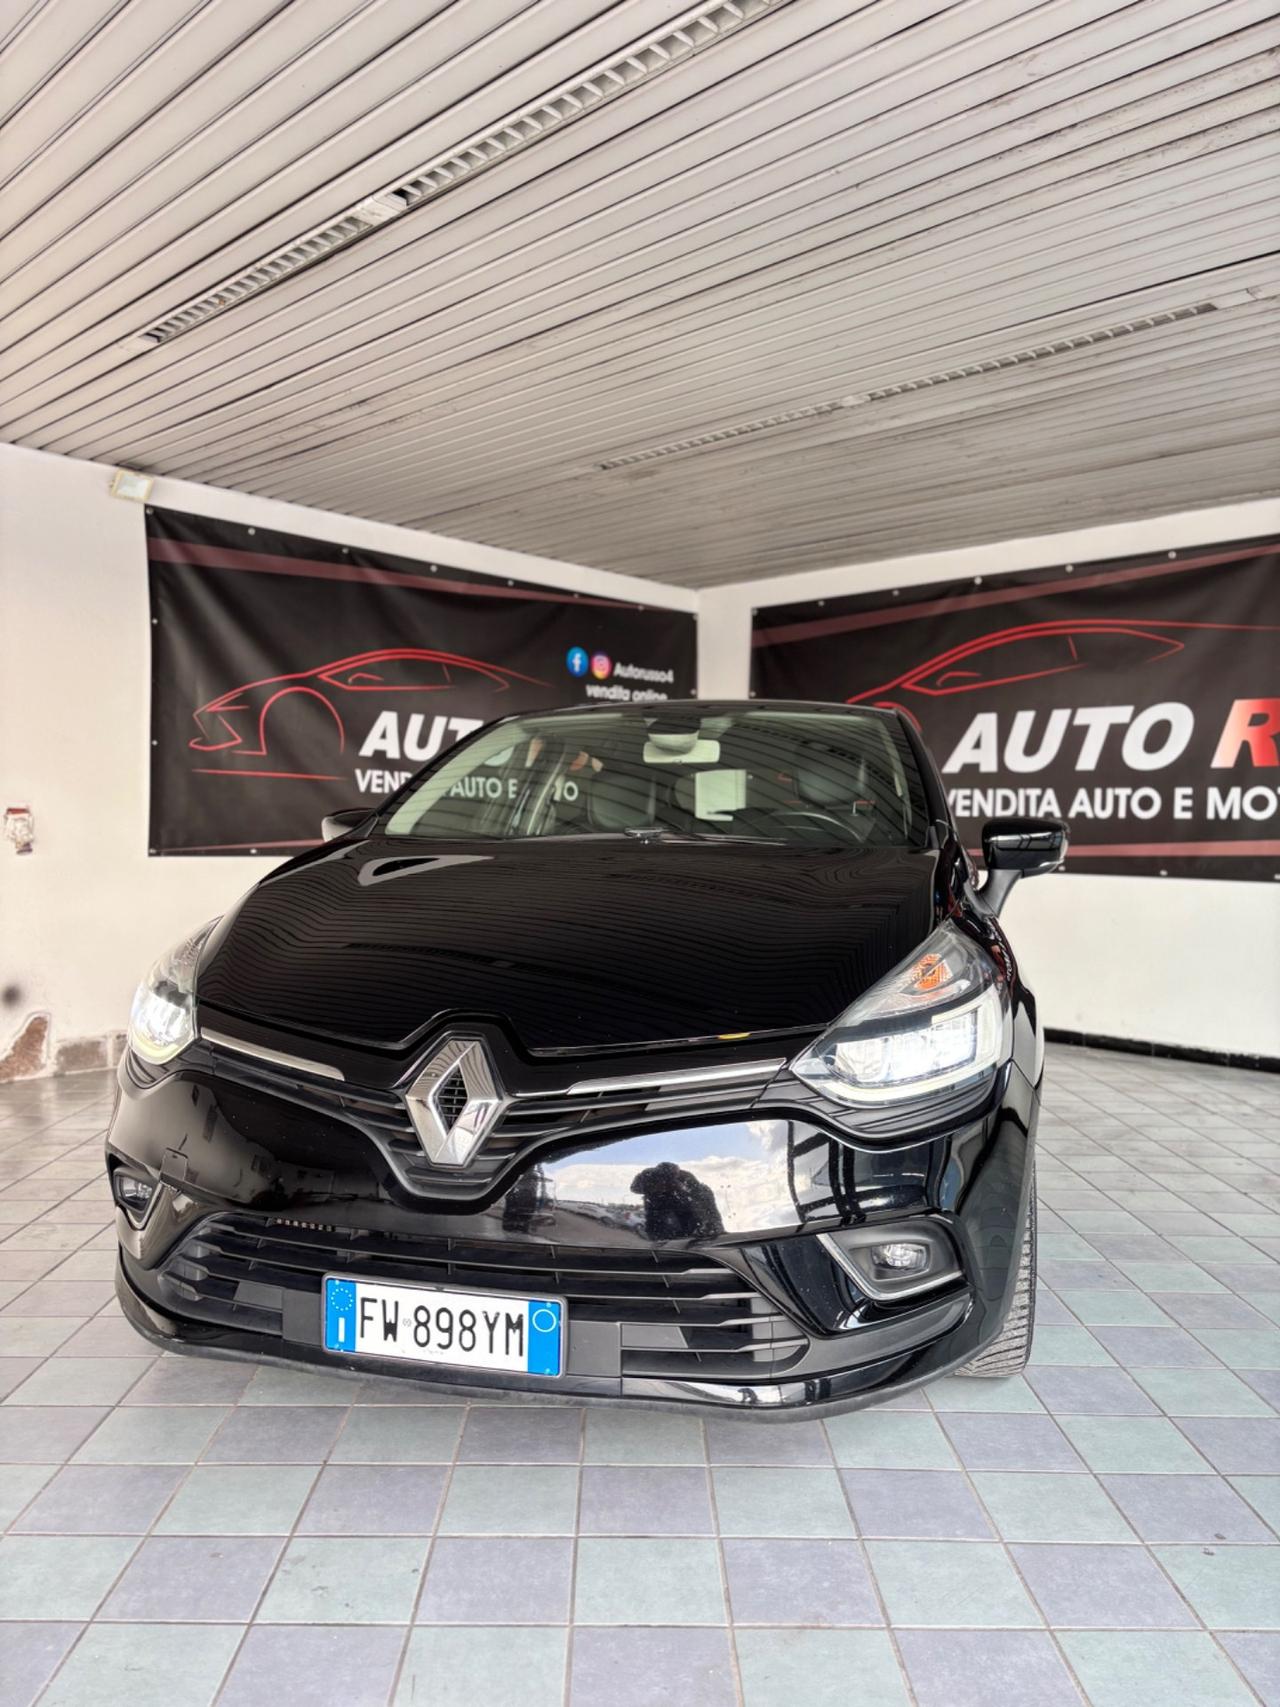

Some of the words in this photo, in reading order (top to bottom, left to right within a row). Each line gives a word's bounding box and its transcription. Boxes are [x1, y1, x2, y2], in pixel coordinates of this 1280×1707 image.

[585, 684, 631, 702] vendita
[632, 689, 668, 703] online
[358, 710, 515, 767] AUT
[941, 702, 1195, 774] AUTO
[1068, 787, 1162, 820] AUTO
[1173, 787, 1193, 820] E
[1206, 785, 1280, 821] MO
